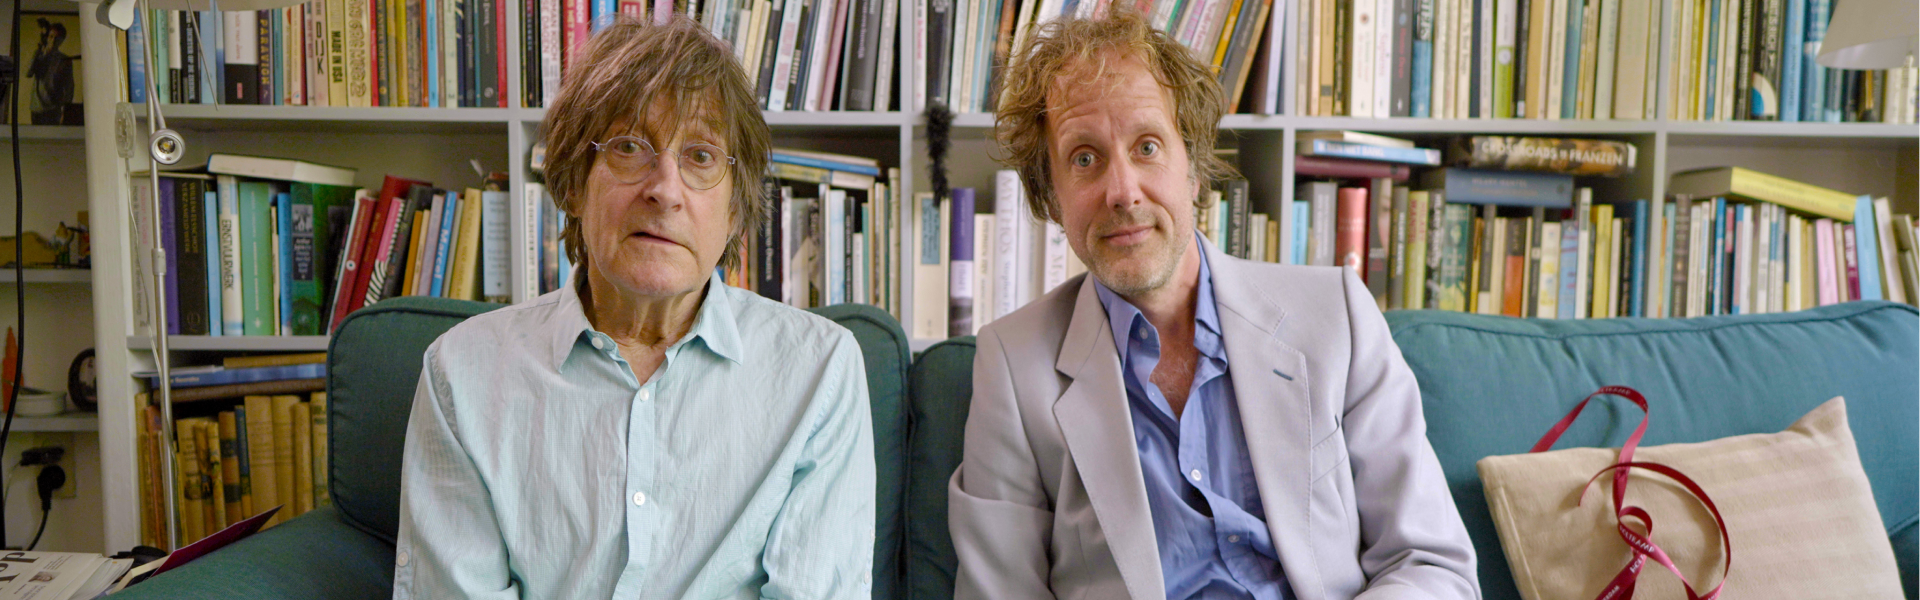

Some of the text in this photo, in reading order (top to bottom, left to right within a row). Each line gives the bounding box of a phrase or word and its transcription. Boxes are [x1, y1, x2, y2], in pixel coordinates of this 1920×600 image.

[186, 27, 195, 54] DICHTER
[260, 19, 270, 85] PARAVION
[331, 31, 343, 83] MADE IN USA
[1481, 140, 1624, 167] CROSSROADS FRANZEN
[1000, 176, 1013, 255] MYTHOS
[434, 229, 449, 280] Marcel
[1002, 260, 1012, 298] Stephen
